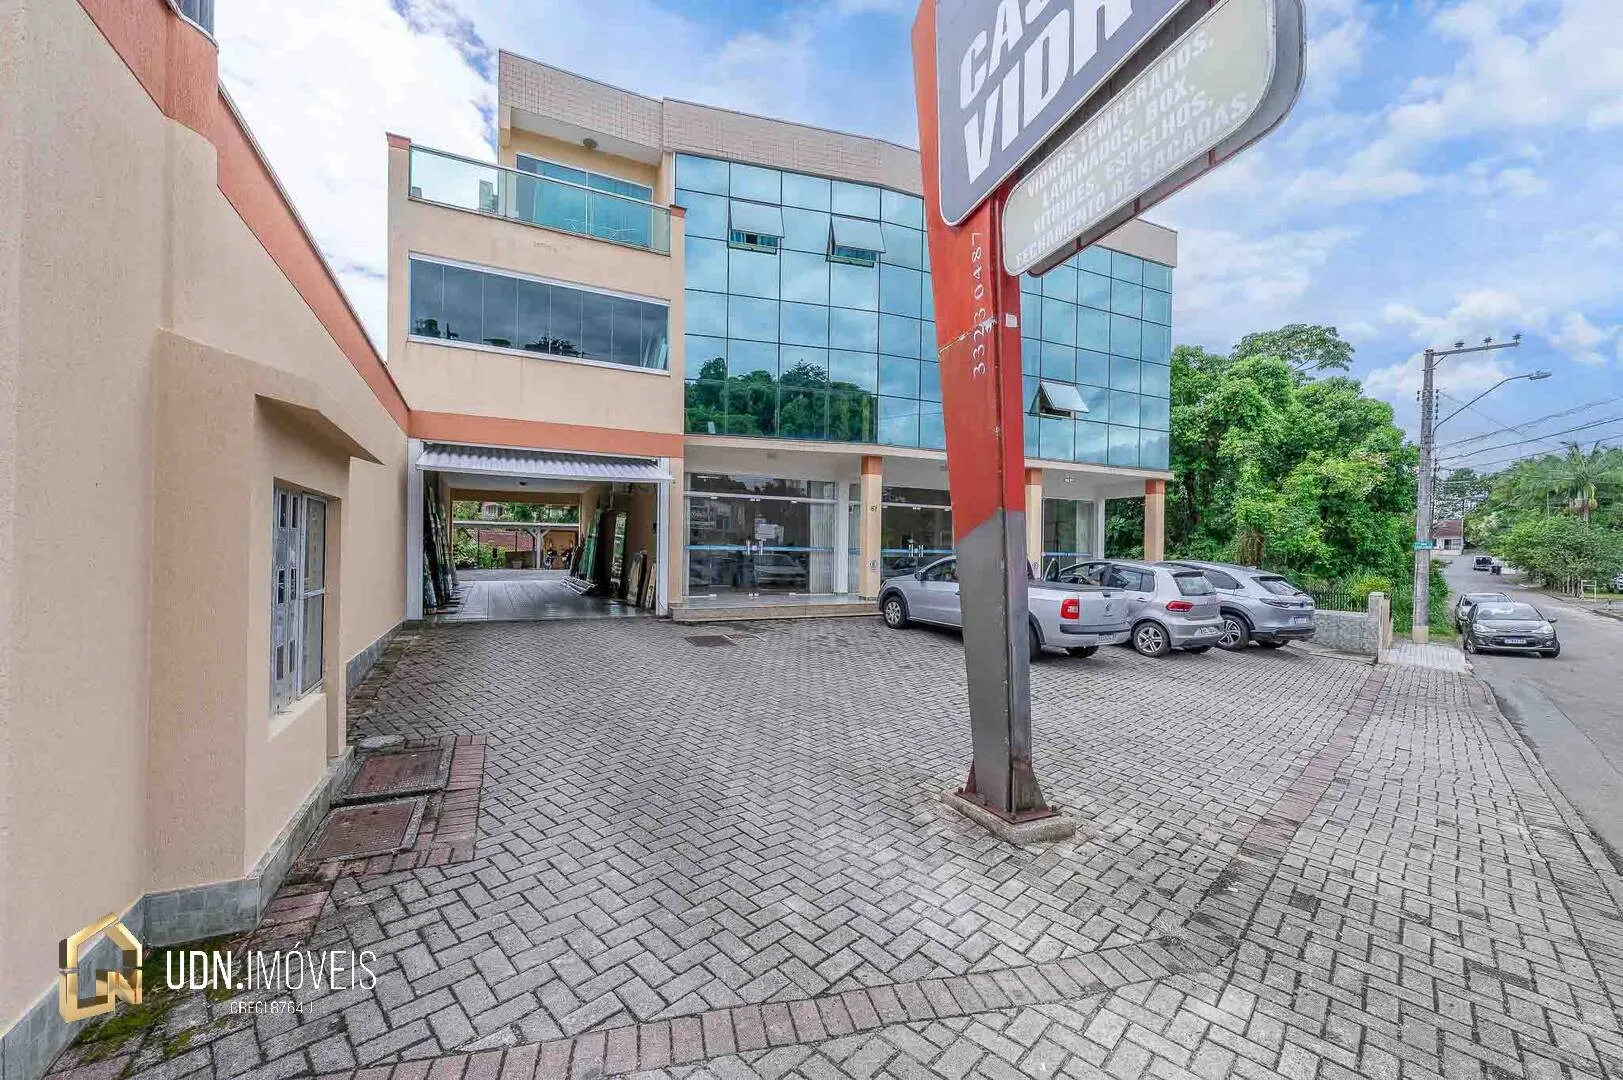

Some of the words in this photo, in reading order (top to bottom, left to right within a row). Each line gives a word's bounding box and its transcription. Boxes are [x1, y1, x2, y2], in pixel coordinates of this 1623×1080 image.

[1027, 150, 1078, 198] VIDROS
[1113, 170, 1137, 200] DE
[1140, 91, 1248, 181] SACADAS
